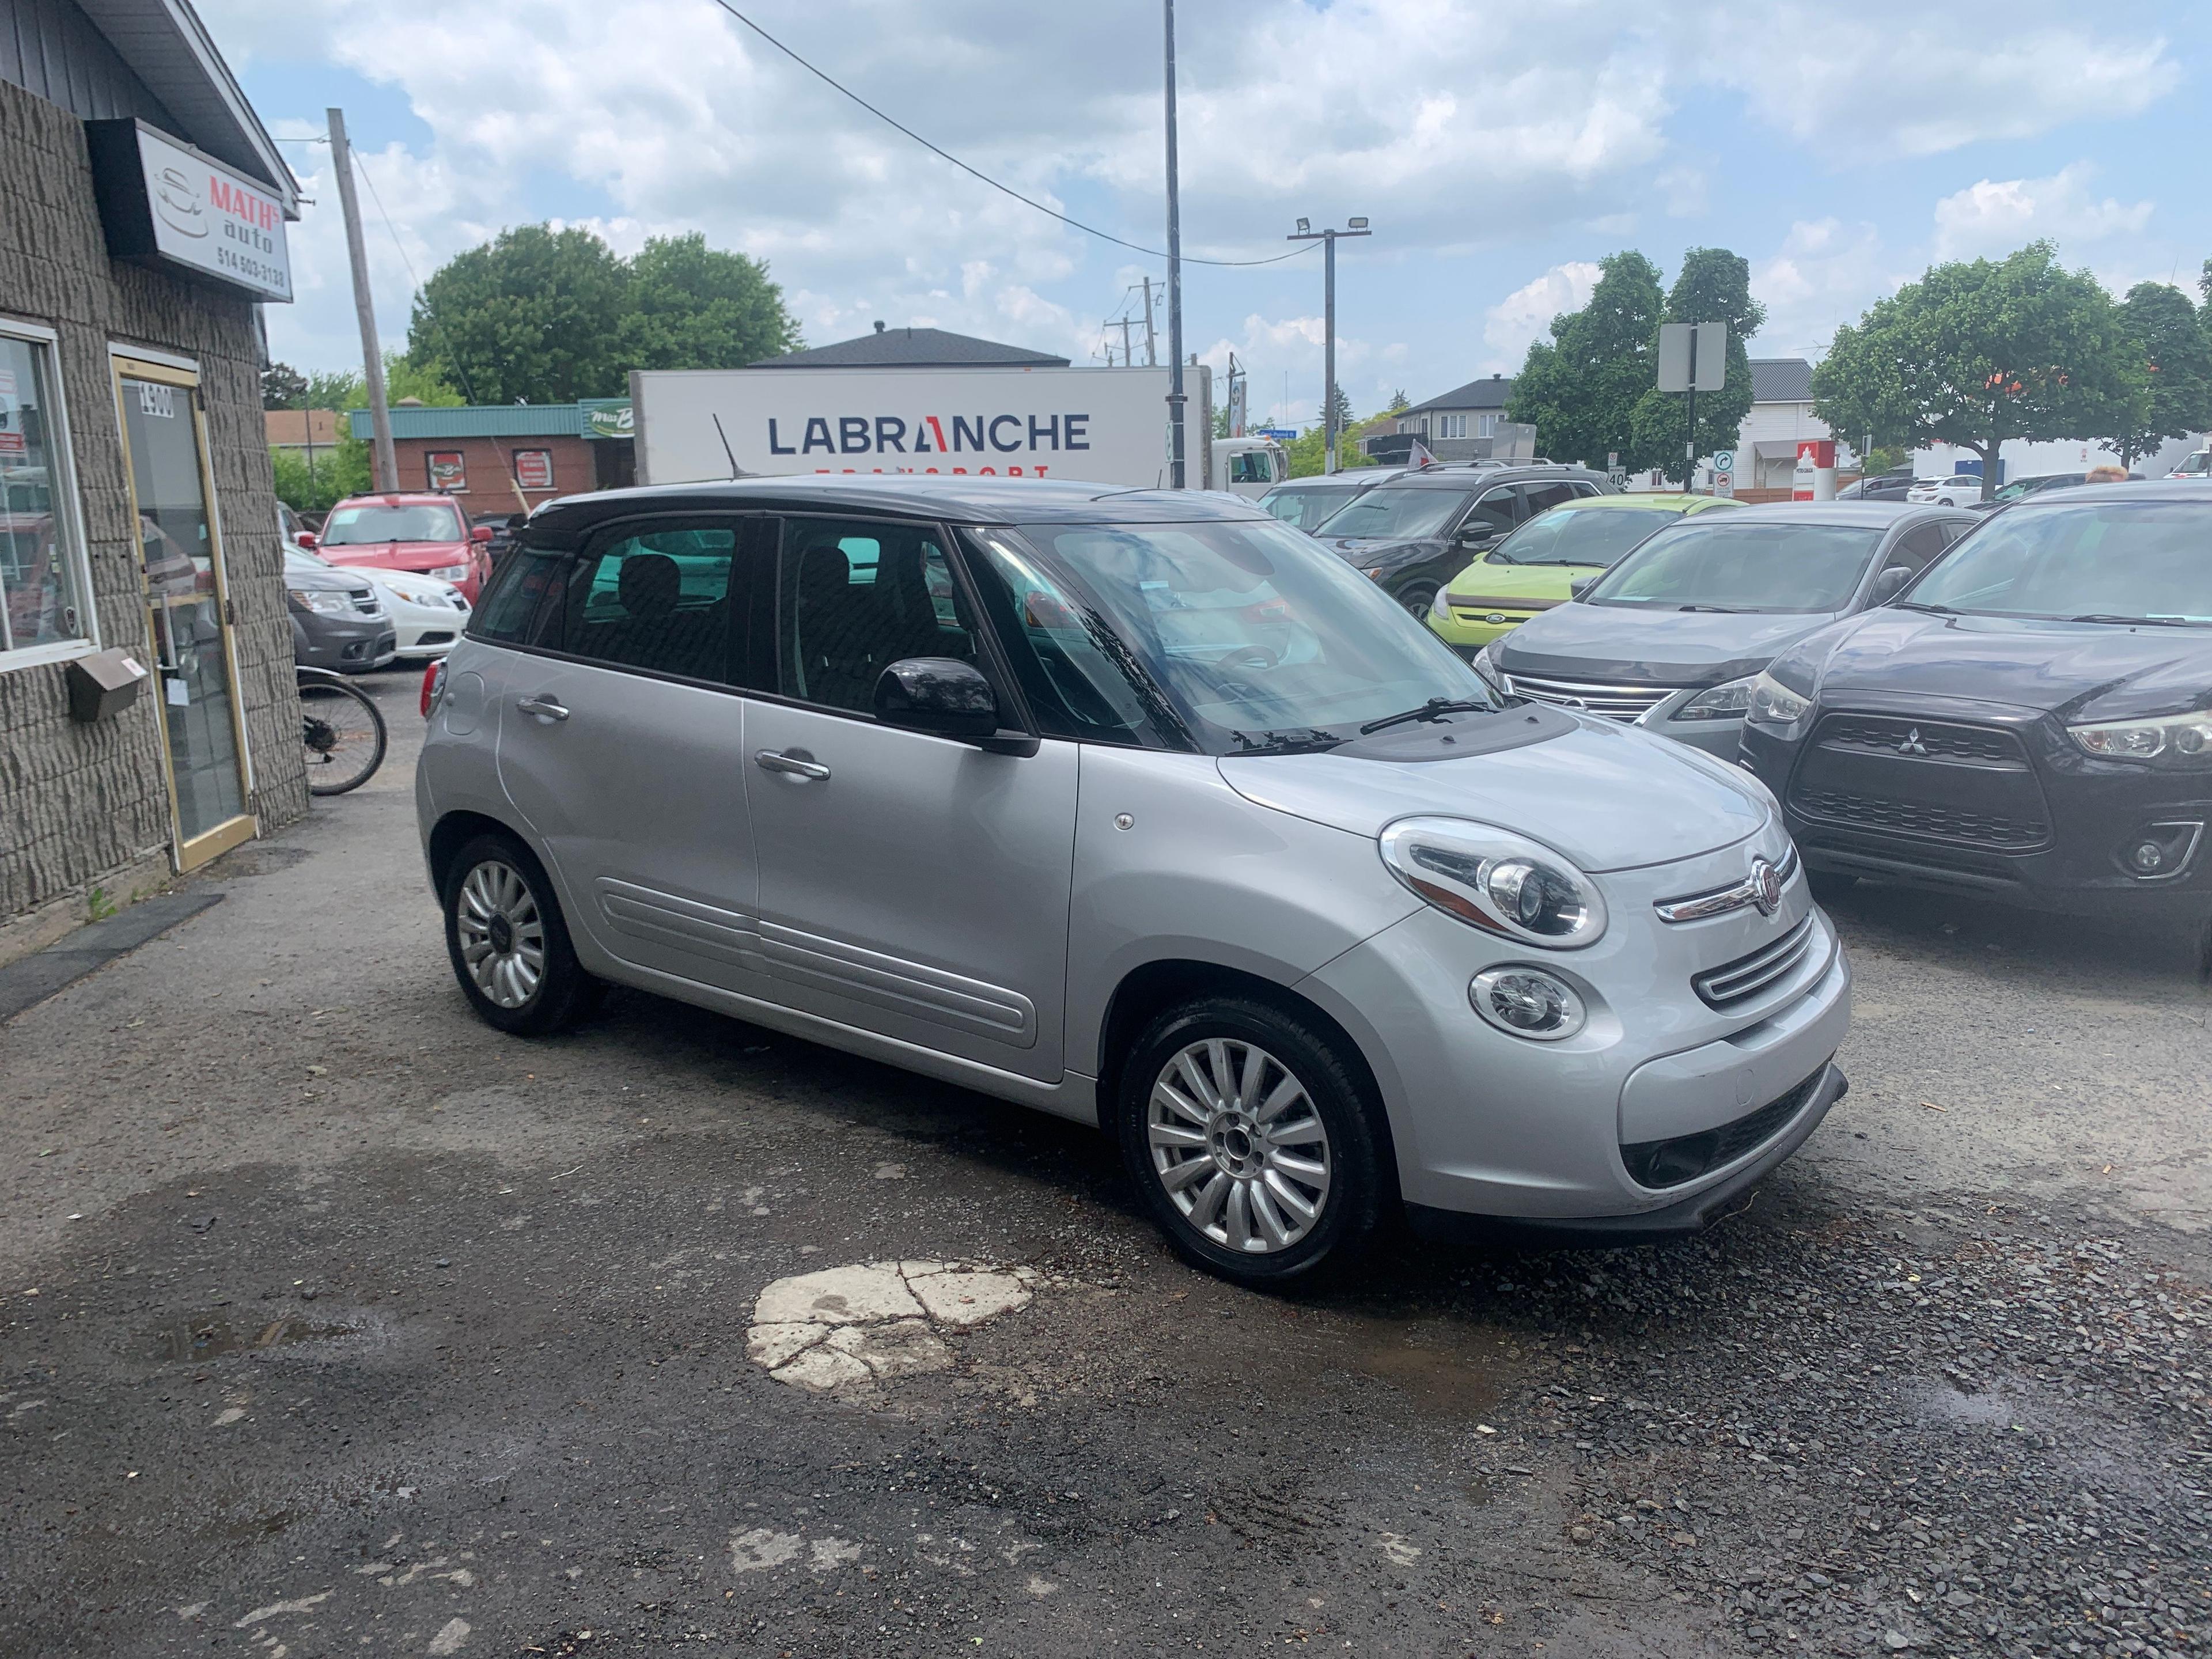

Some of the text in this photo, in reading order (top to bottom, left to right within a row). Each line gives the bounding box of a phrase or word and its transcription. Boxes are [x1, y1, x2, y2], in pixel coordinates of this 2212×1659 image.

[225, 219, 271, 253] auto
[218, 246, 237, 269] 514
[768, 414, 1090, 454] LABRANCHE
[1609, 474, 1623, 486] 40
